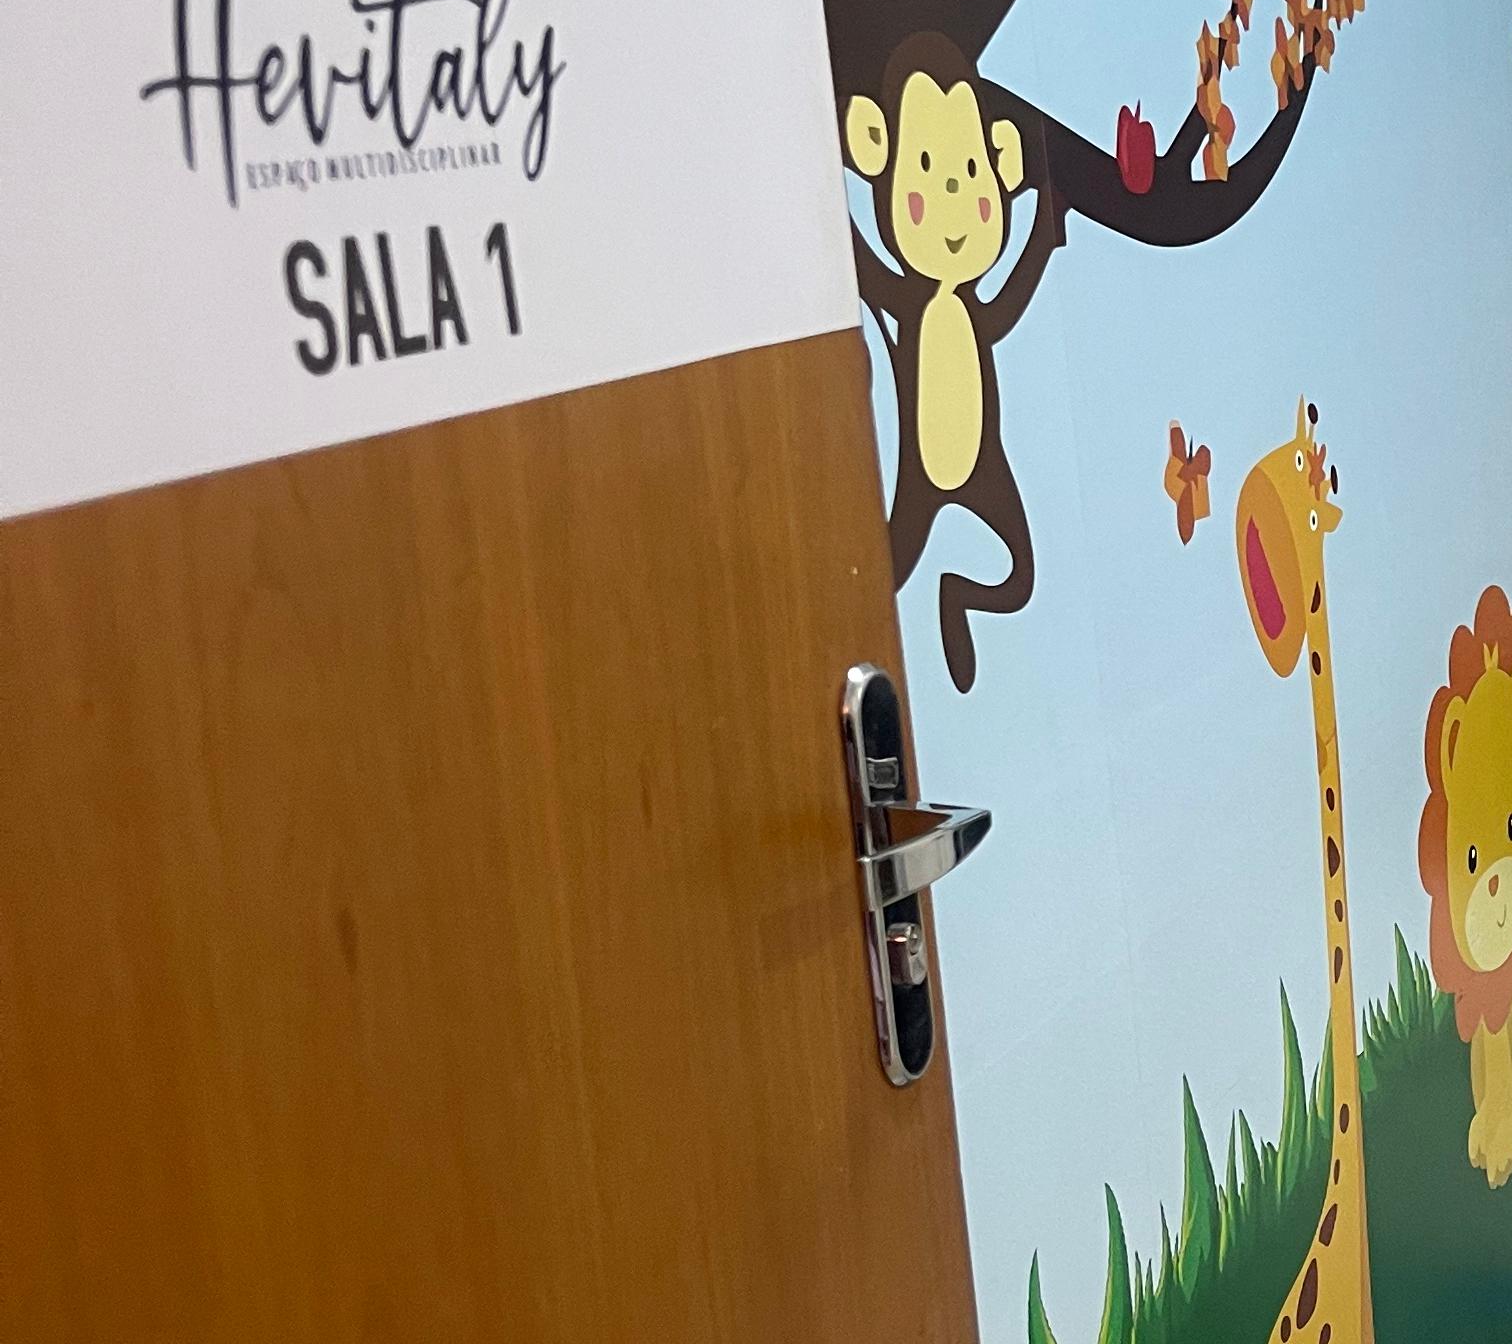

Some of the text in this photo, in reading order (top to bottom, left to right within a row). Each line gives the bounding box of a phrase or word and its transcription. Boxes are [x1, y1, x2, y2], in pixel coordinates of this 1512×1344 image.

[245, 142, 501, 192] ESPAÇO MULTIDISCIPLINAR
[283, 222, 523, 376] SALA 1
